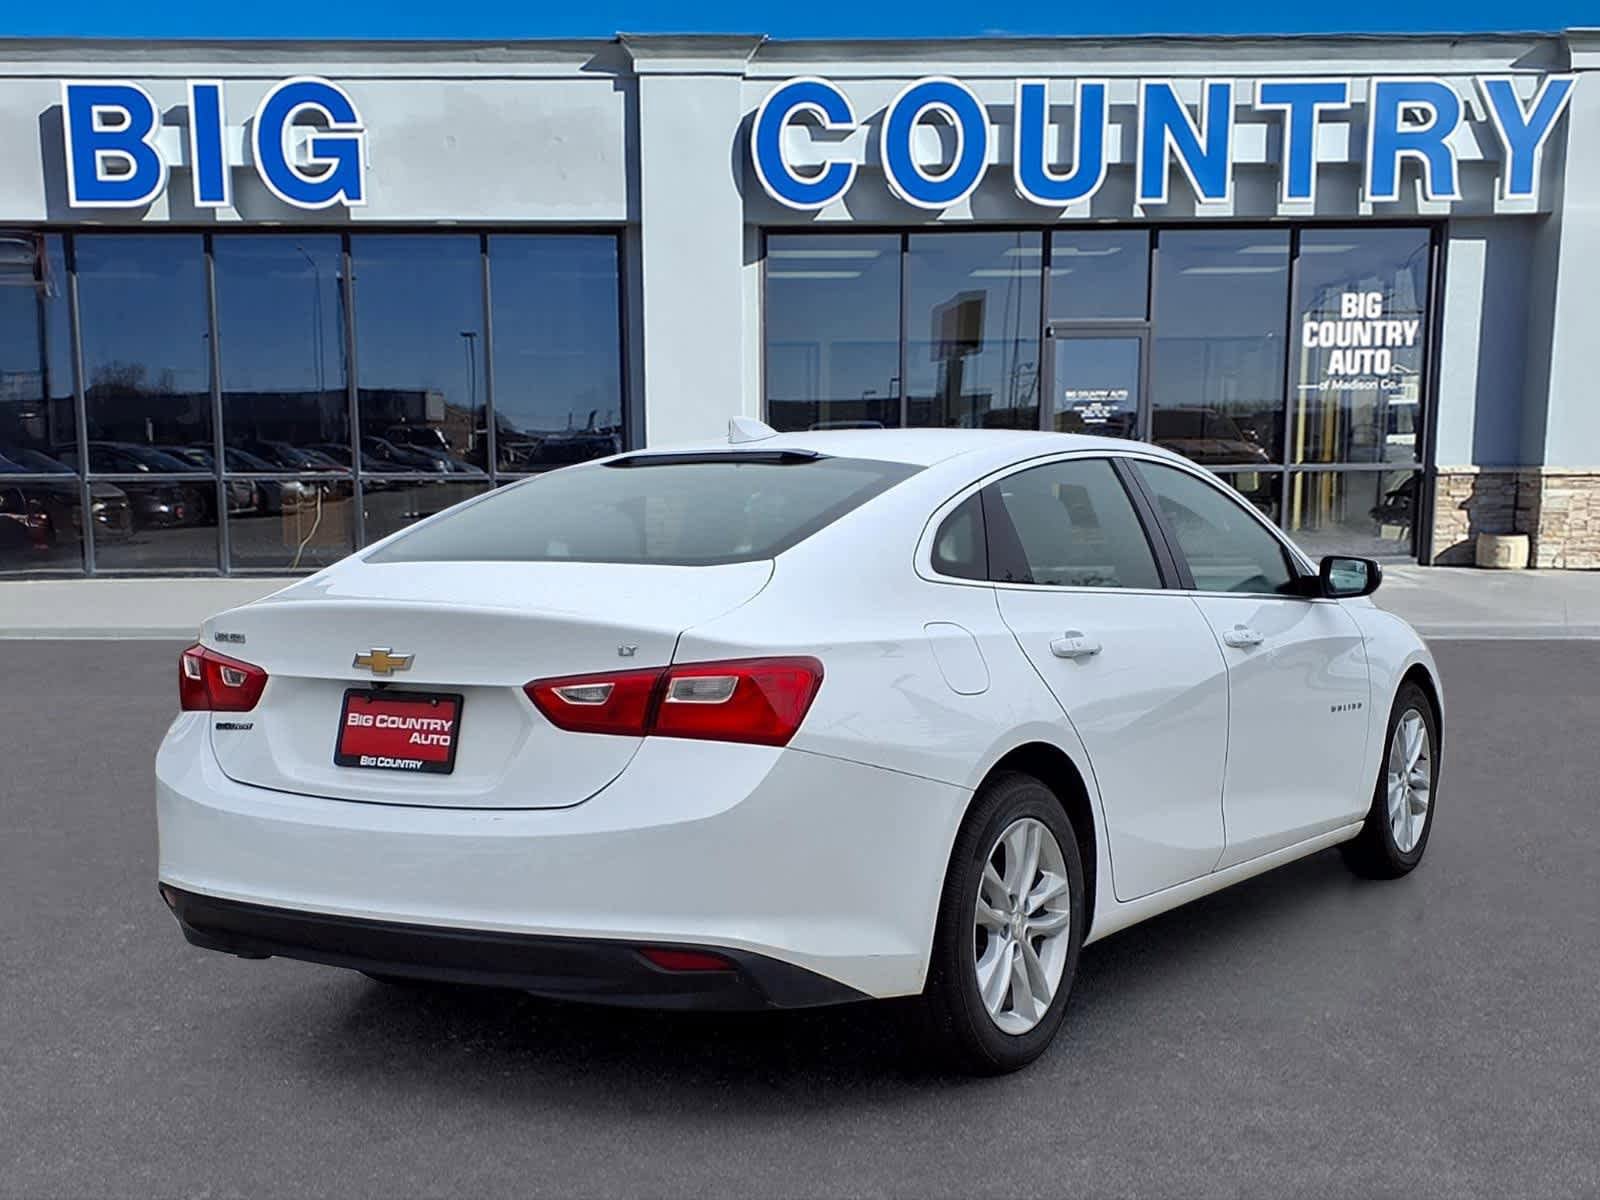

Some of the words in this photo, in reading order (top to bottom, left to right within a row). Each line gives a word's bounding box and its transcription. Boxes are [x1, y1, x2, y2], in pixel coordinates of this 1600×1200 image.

[60, 76, 368, 209] BIG
[751, 74, 1577, 214] COUNTRY
[1341, 292, 1382, 319] BIG
[1303, 320, 1420, 348] COUNTRY
[1328, 349, 1391, 376] AUTO
[347, 713, 374, 727] BIG
[375, 714, 453, 732] COUNTRY
[409, 732, 451, 746] AUTO
[377, 756, 424, 769] COUNTRY
